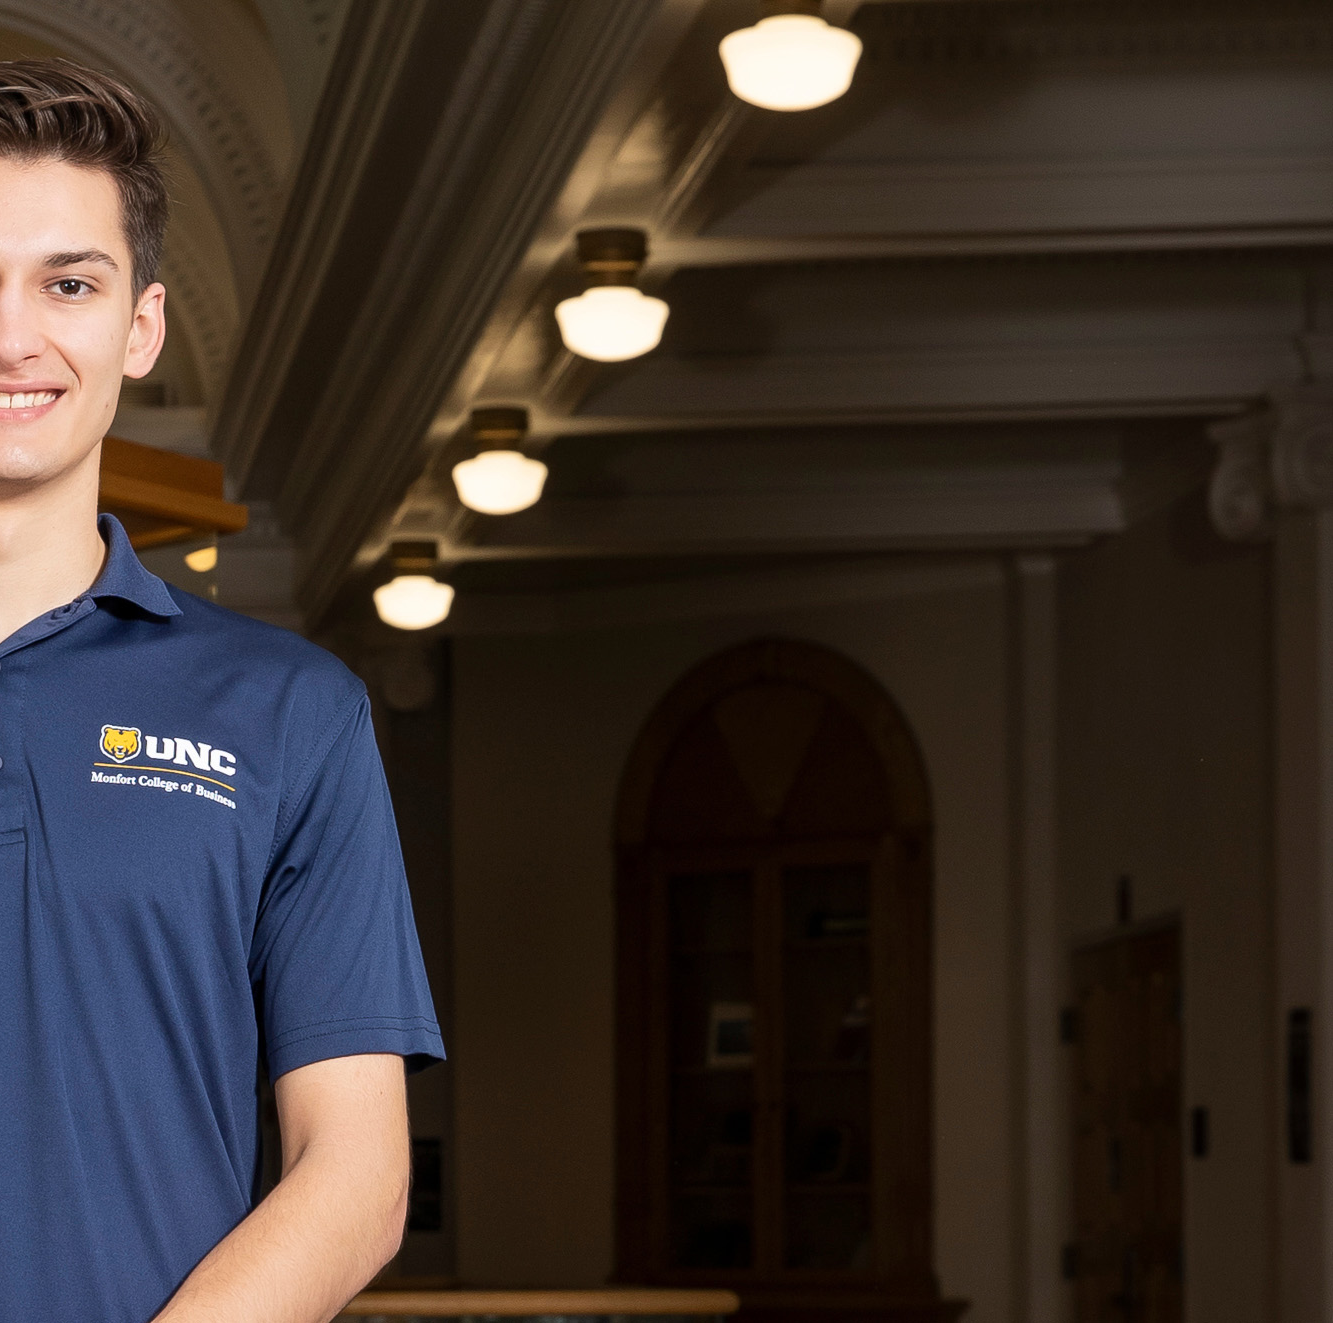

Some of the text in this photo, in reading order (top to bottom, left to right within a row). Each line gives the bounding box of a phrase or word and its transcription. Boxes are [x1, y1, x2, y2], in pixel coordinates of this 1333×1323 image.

[145, 735, 237, 776] UNC
[91, 771, 136, 785] Monfort
[138, 775, 179, 792] College
[181, 783, 193, 793] of
